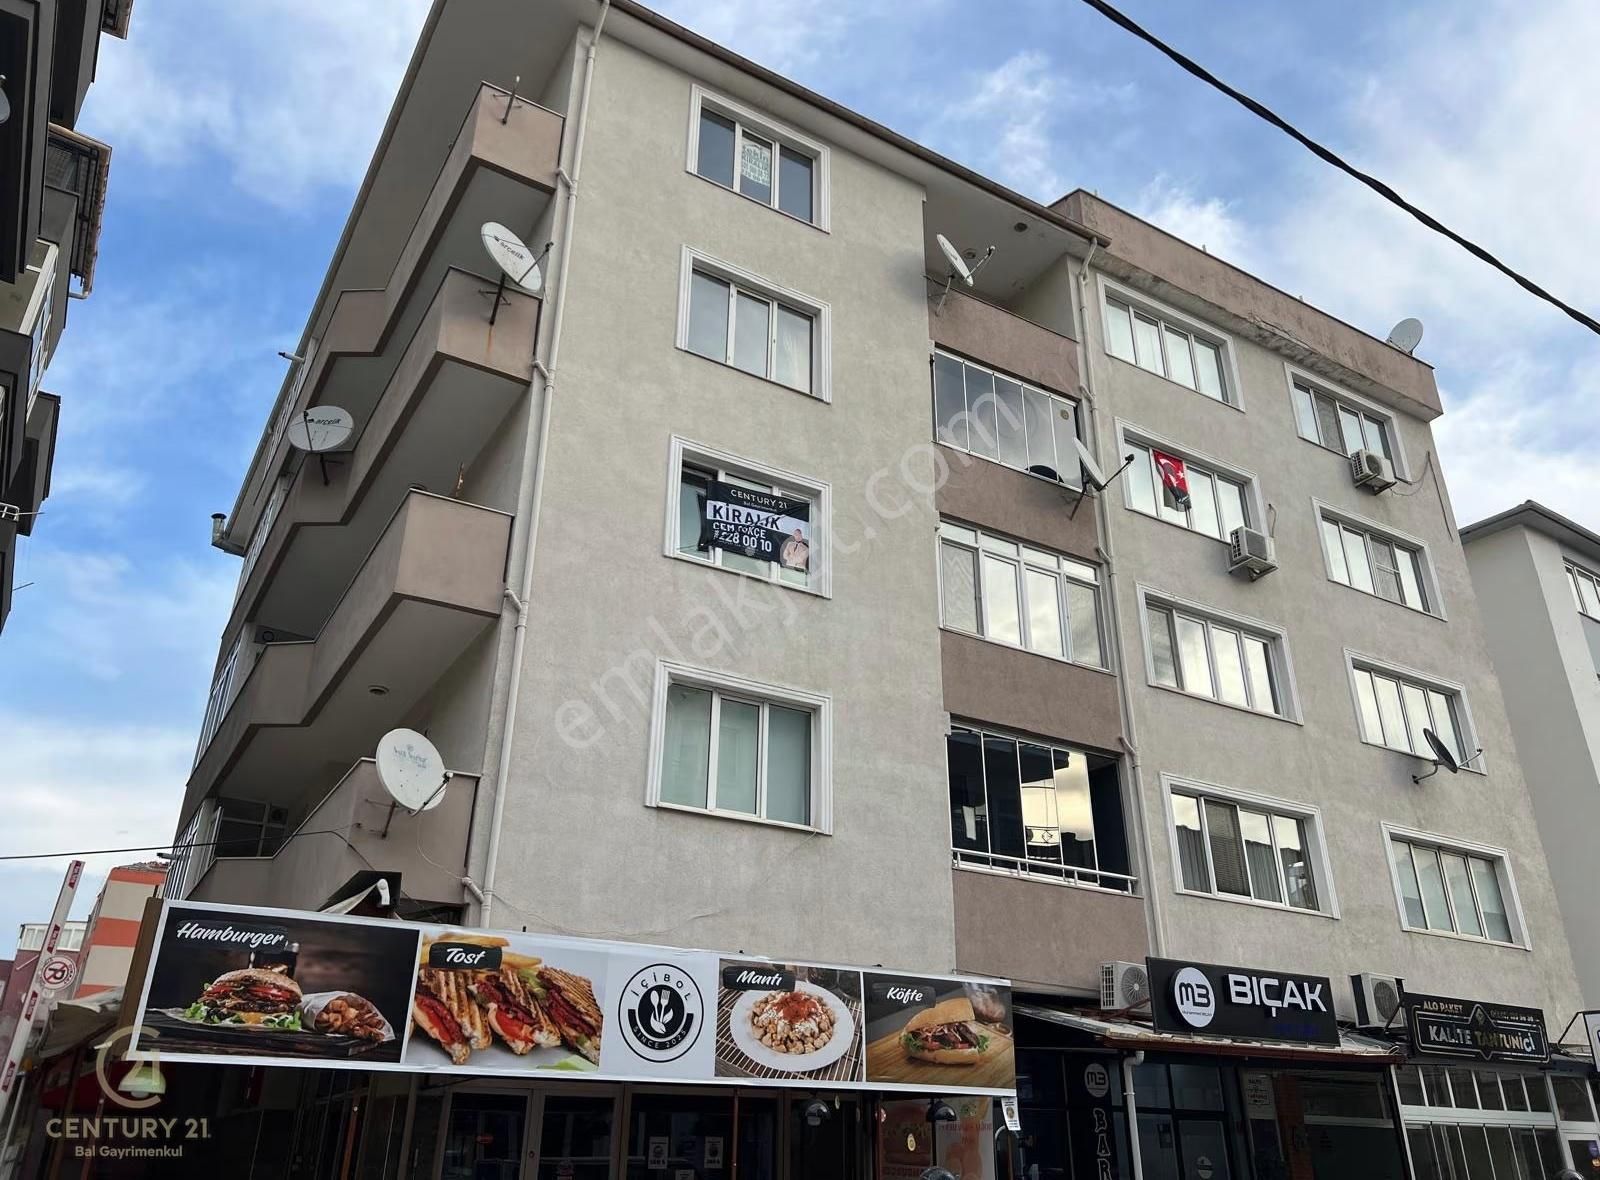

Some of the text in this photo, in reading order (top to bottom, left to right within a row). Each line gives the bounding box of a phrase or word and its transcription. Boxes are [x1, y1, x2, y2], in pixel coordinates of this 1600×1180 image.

[730, 489, 777, 507] CENTURY
[778, 501, 788, 509] 21
[742, 534, 758, 548] 00
[761, 539, 772, 552] 10
[177, 922, 285, 948] Hamburger
[446, 948, 486, 965] Tost
[736, 970, 782, 986] Mantı
[886, 986, 924, 1002] Köfte
[1179, 982, 1210, 1008] MB
[1228, 973, 1327, 1018] BIÇAK
[1423, 1000, 1439, 1011] ALO
[633, 1026, 687, 1049] SINCE 2025
[1429, 1025, 1473, 1045] KALTE
